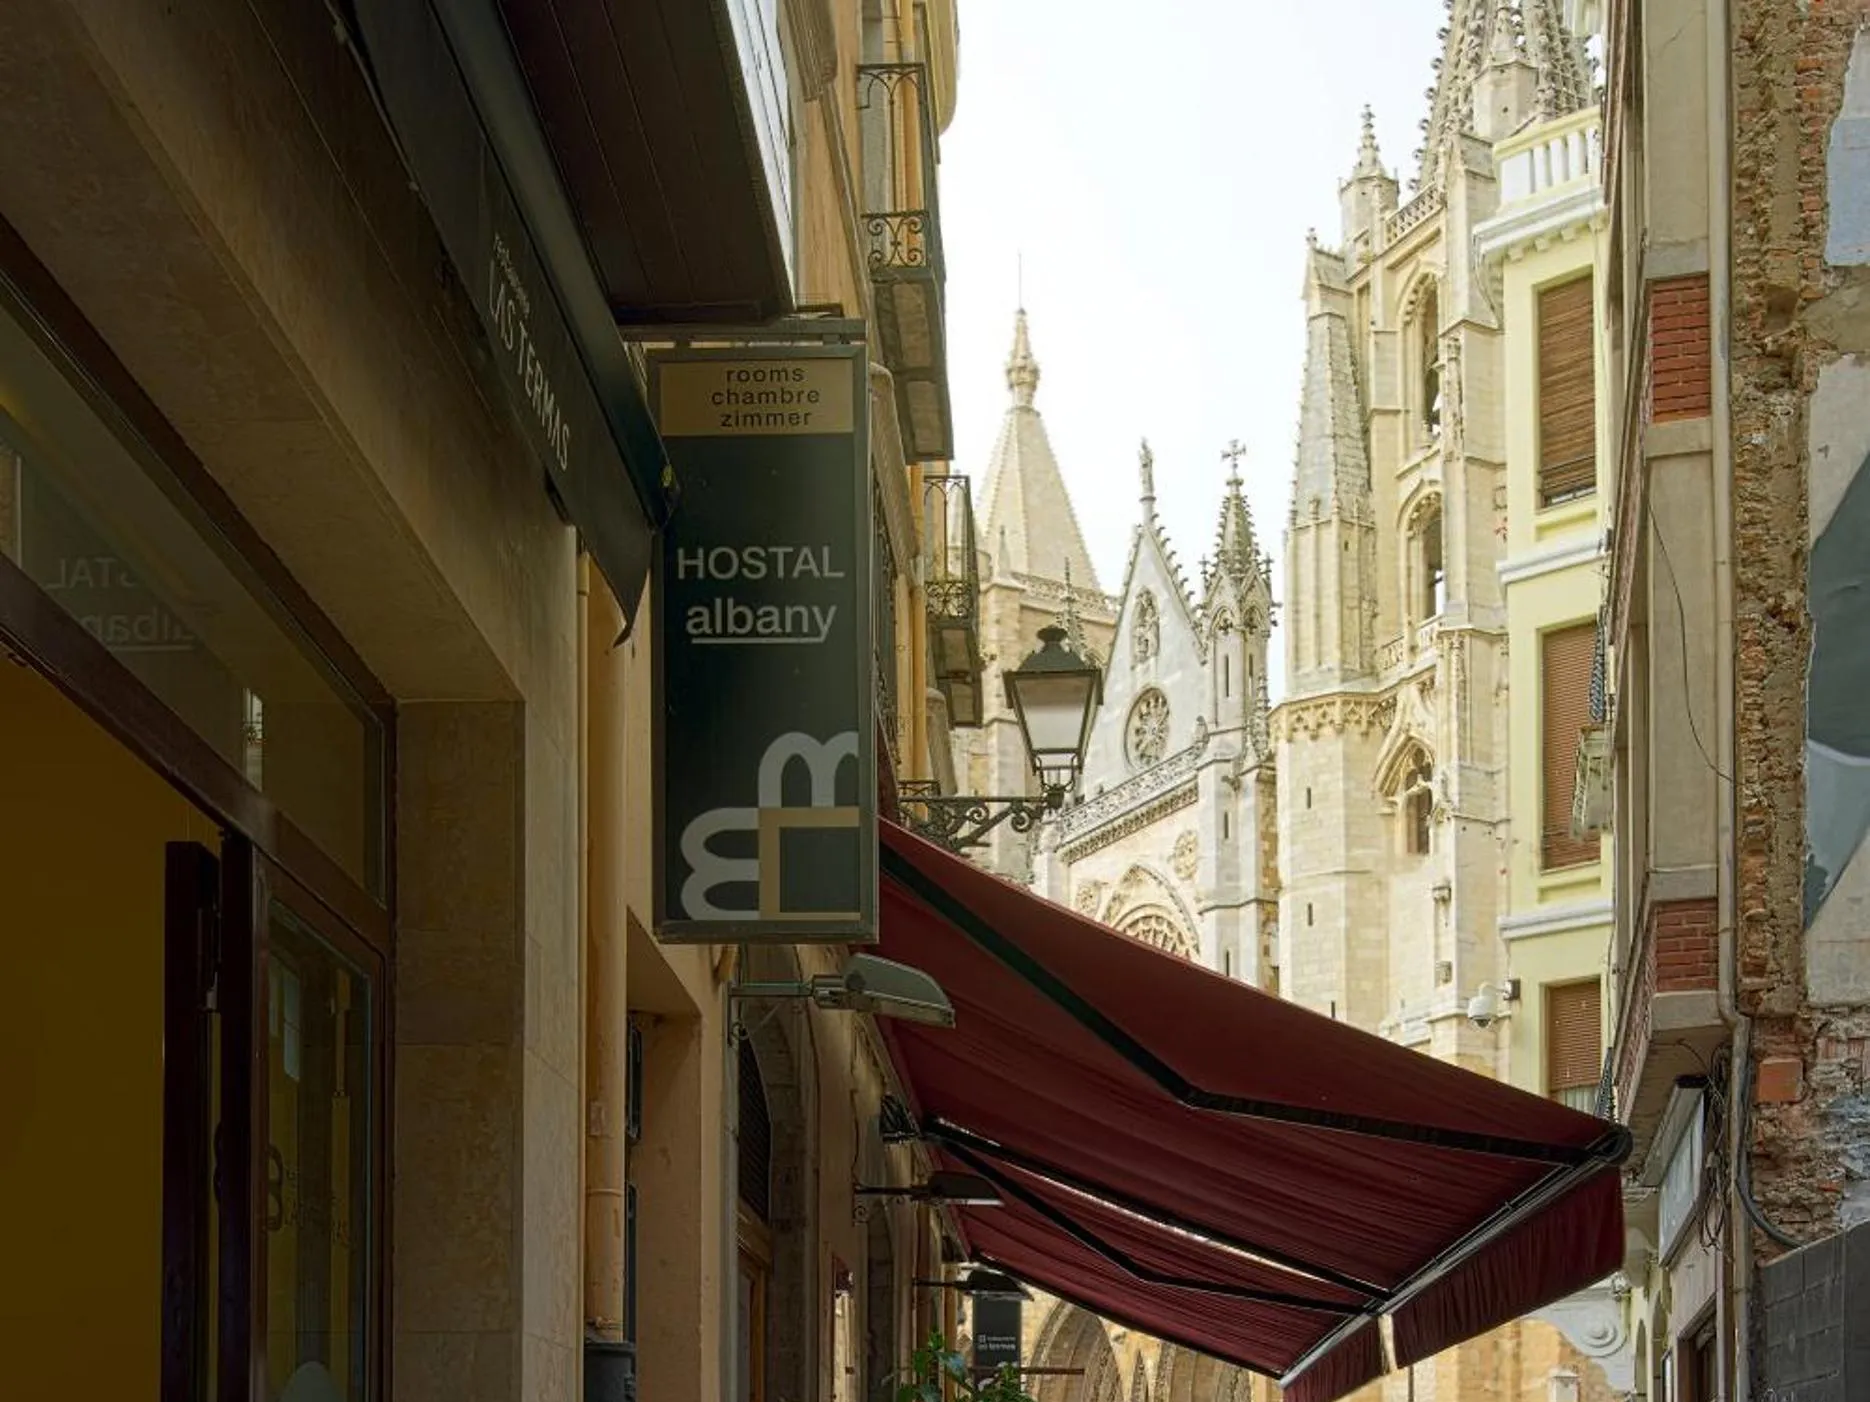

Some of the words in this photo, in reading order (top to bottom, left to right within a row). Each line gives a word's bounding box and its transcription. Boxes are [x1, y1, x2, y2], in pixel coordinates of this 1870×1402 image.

[488, 258, 516, 352] LAS
[517, 319, 570, 472] TERMAS
[726, 367, 805, 383] rooms
[711, 387, 821, 406] chambre
[719, 410, 813, 429] zimmer
[677, 546, 846, 581] HOSTAL
[685, 597, 838, 644] albany
